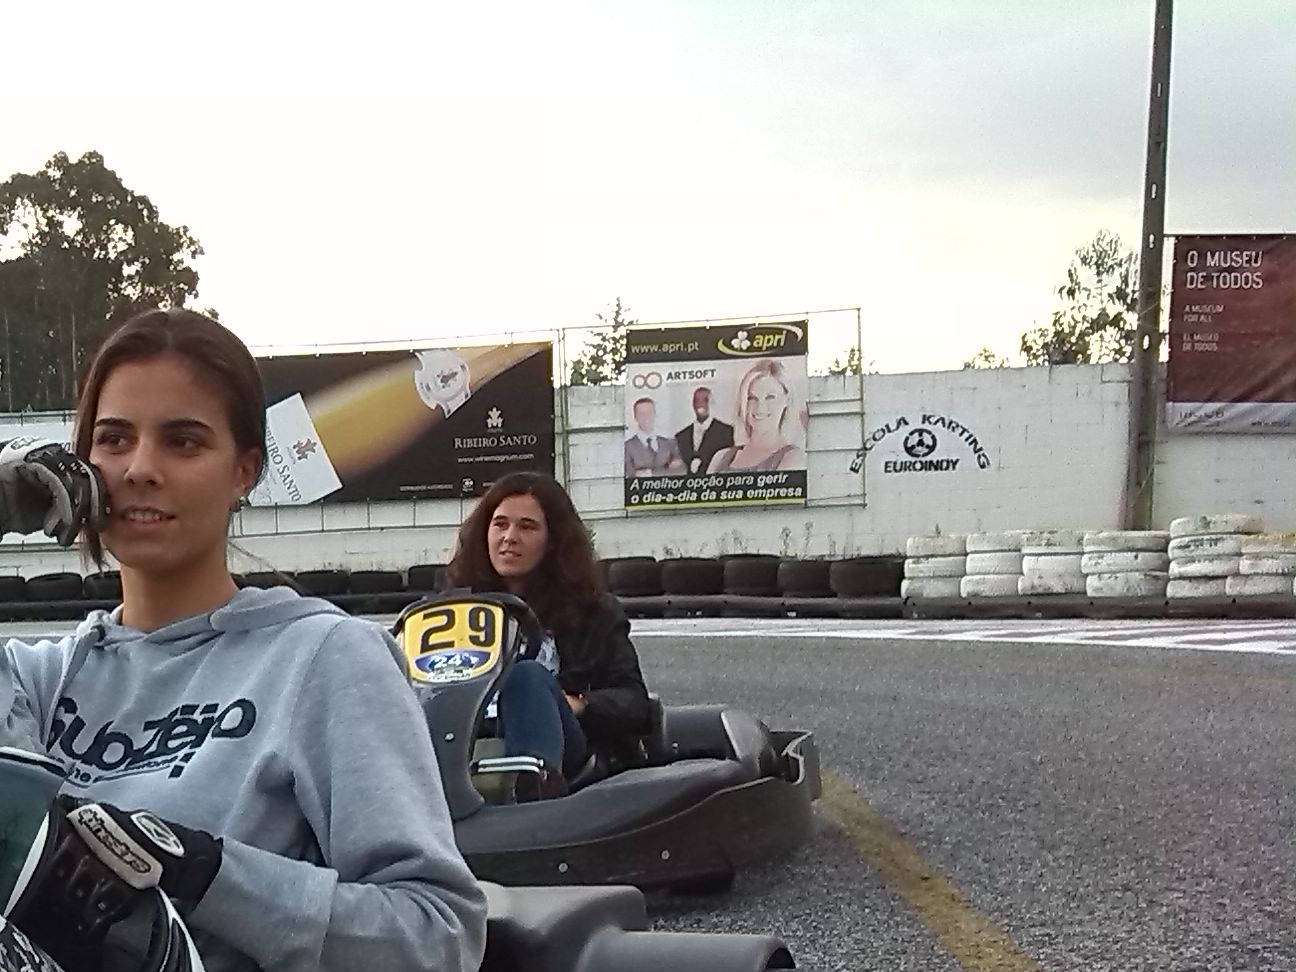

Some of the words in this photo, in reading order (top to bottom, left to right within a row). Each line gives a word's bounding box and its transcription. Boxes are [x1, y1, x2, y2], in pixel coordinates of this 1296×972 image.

[1187, 251, 1198, 267] O
[1206, 251, 1263, 267] MUSEU
[1186, 272, 1206, 288] DE
[1211, 272, 1263, 289] TODOS
[631, 341, 699, 353] www.apri.pt
[753, 330, 788, 350] apri
[666, 369, 716, 381] ARTSOFT
[454, 437, 498, 449] RIBEIRO
[499, 434, 537, 447] SANTO
[849, 416, 910, 474] ESCOLA
[921, 414, 991, 470] KARTING
[884, 458, 960, 473] EUROINDY
[630, 479, 639, 491] A
[642, 477, 683, 490] melhor
[686, 476, 723, 489] opção
[726, 475, 754, 488] para
[757, 473, 788, 486] gerir
[631, 494, 640, 504] o
[642, 490, 698, 503] dia-a-dia
[701, 489, 716, 500] da
[720, 490, 743, 499] sua
[747, 487, 802, 501] empresa
[420, 606, 496, 654] 29
